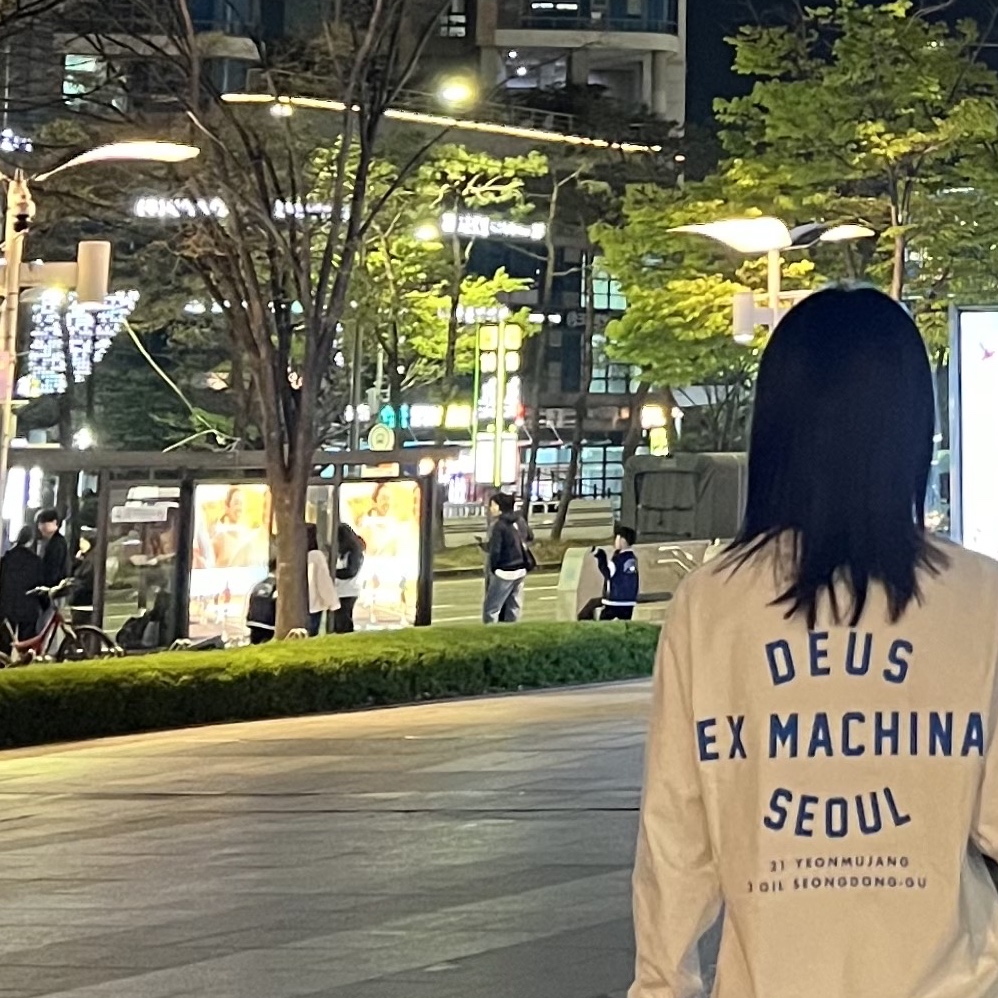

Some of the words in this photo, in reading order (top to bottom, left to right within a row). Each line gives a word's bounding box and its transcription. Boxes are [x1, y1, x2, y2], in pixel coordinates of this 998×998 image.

[765, 631, 913, 685] DEUS
[696, 714, 747, 762] EX
[768, 711, 985, 758] MACHINA
[763, 786, 911, 838] SEOUL
[770, 860, 785, 872] 21
[795, 856, 910, 868] YEONMUJANG
